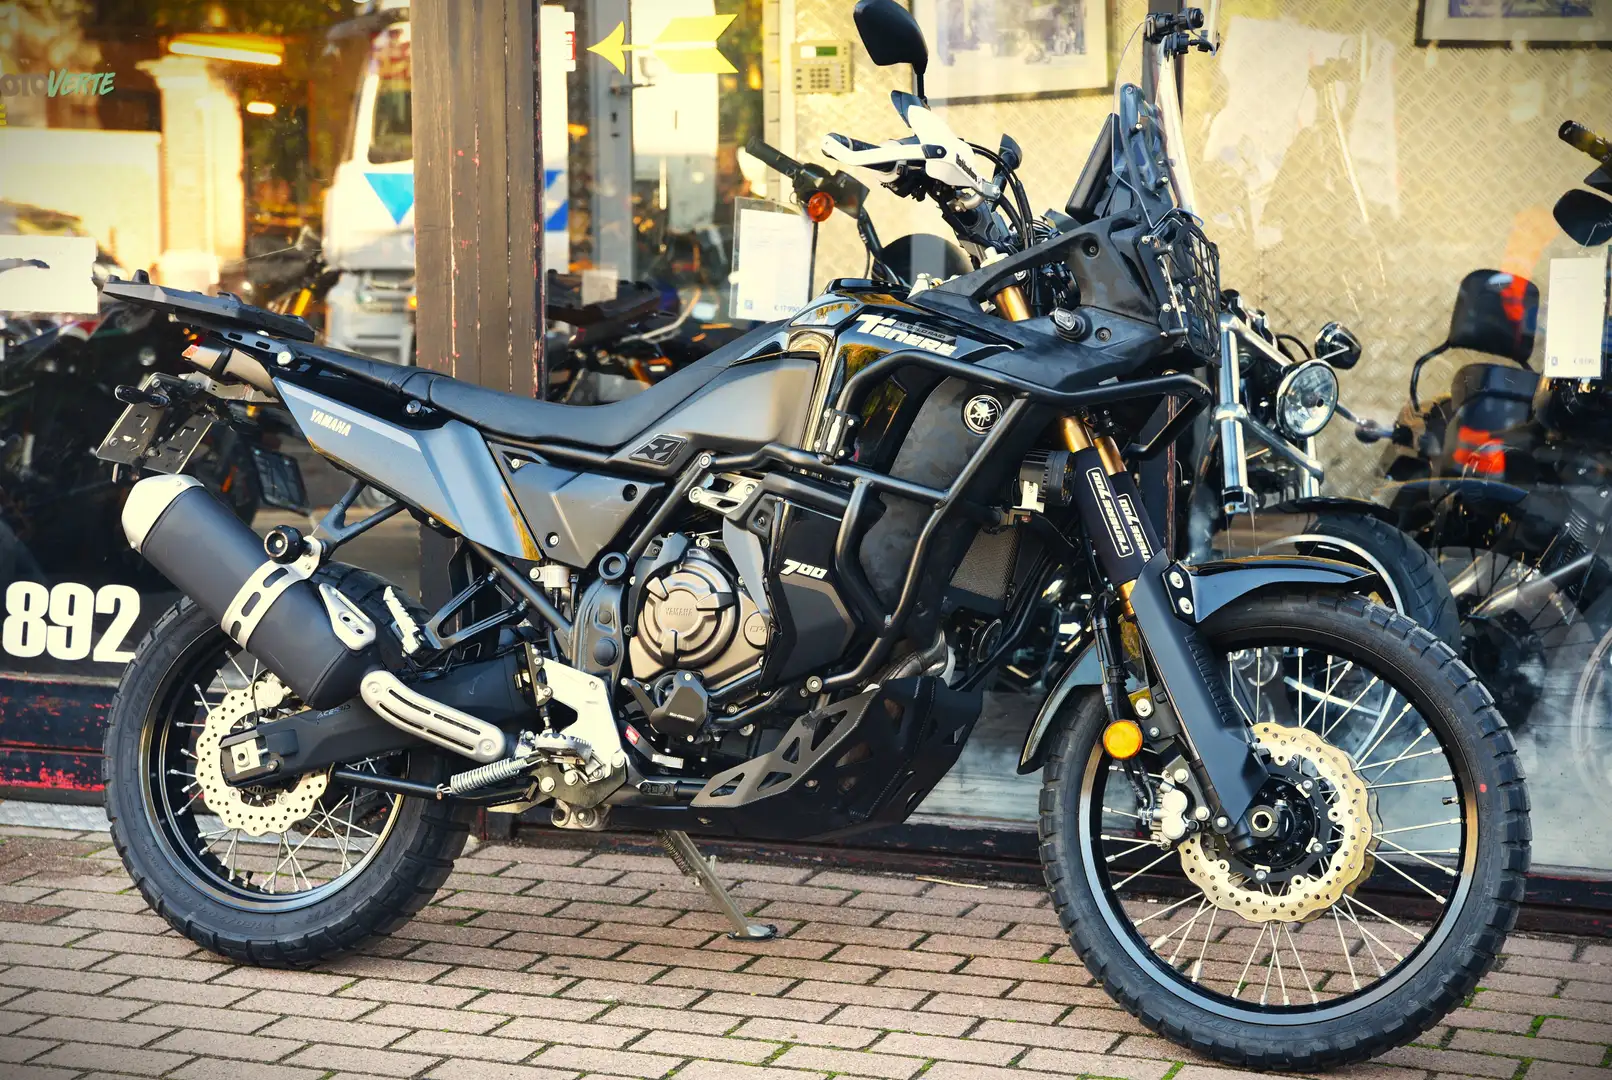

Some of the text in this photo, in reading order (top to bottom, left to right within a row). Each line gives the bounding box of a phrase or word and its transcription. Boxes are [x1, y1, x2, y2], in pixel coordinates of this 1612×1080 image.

[310, 409, 352, 437] YAMAHA
[1091, 471, 1112, 500] 700
[1129, 525, 1152, 563] NERE
[780, 558, 828, 580] 700
[2, 581, 140, 663] 892
